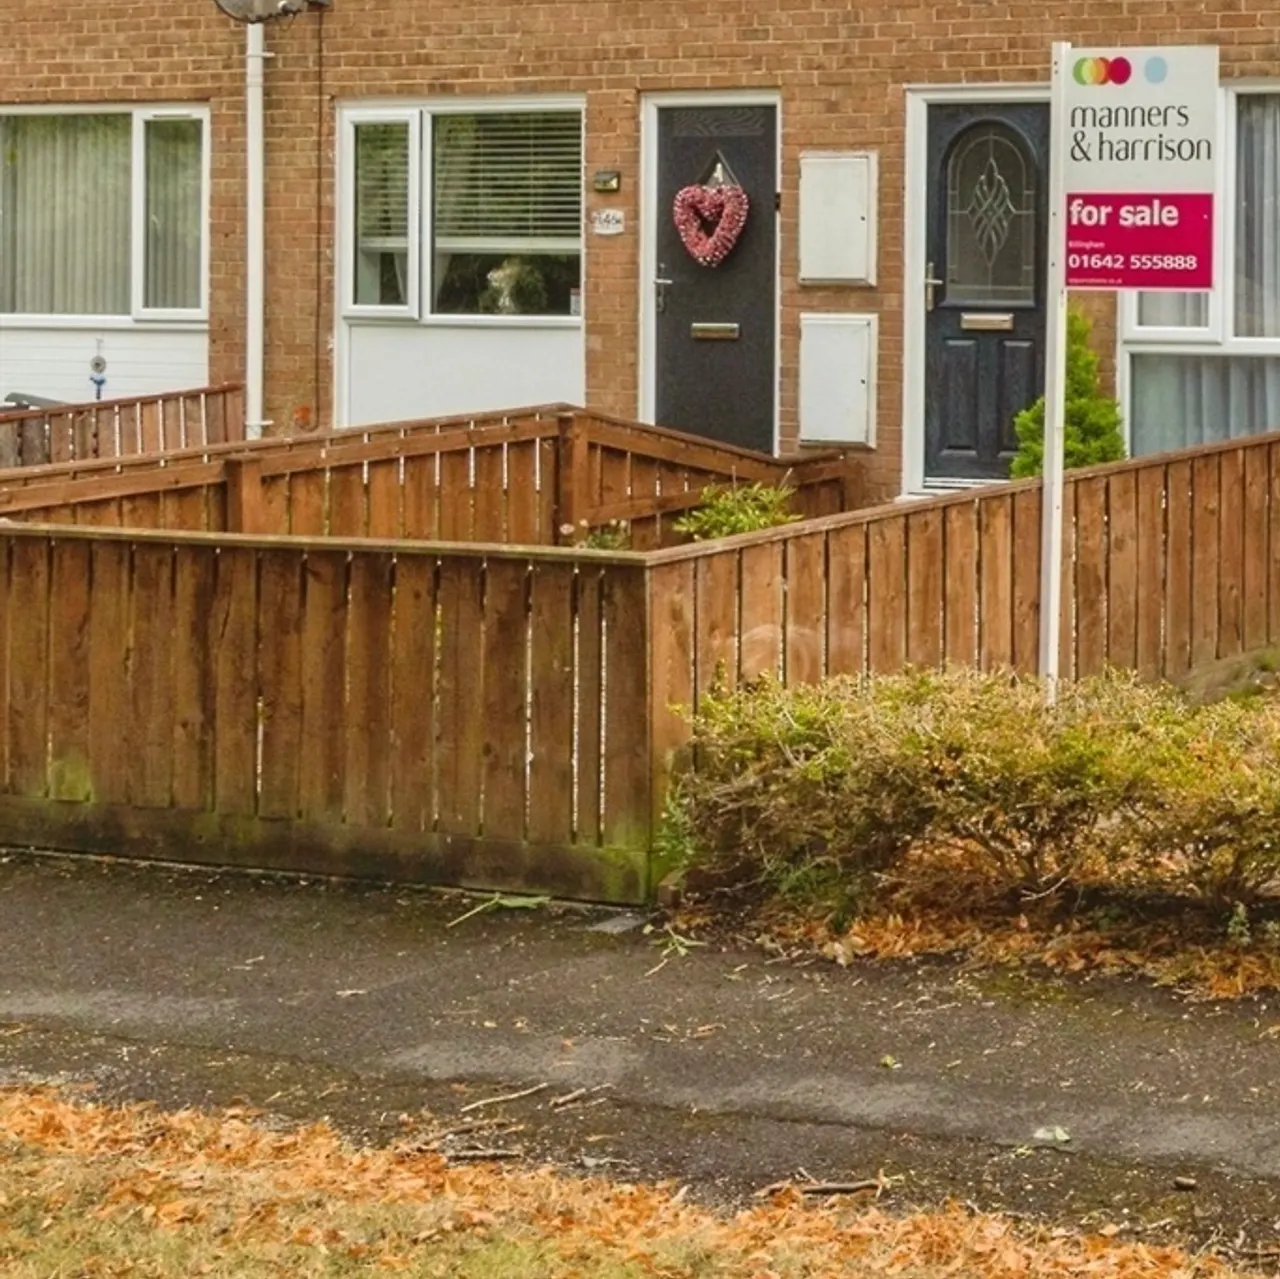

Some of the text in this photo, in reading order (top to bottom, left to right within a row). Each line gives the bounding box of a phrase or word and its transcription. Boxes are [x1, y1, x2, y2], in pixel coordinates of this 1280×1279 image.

[1070, 105, 1189, 128] manners
[1070, 130, 1212, 162] & harrison
[1069, 199, 1179, 226] for sale
[1068, 254, 1198, 269] 01642 555888
